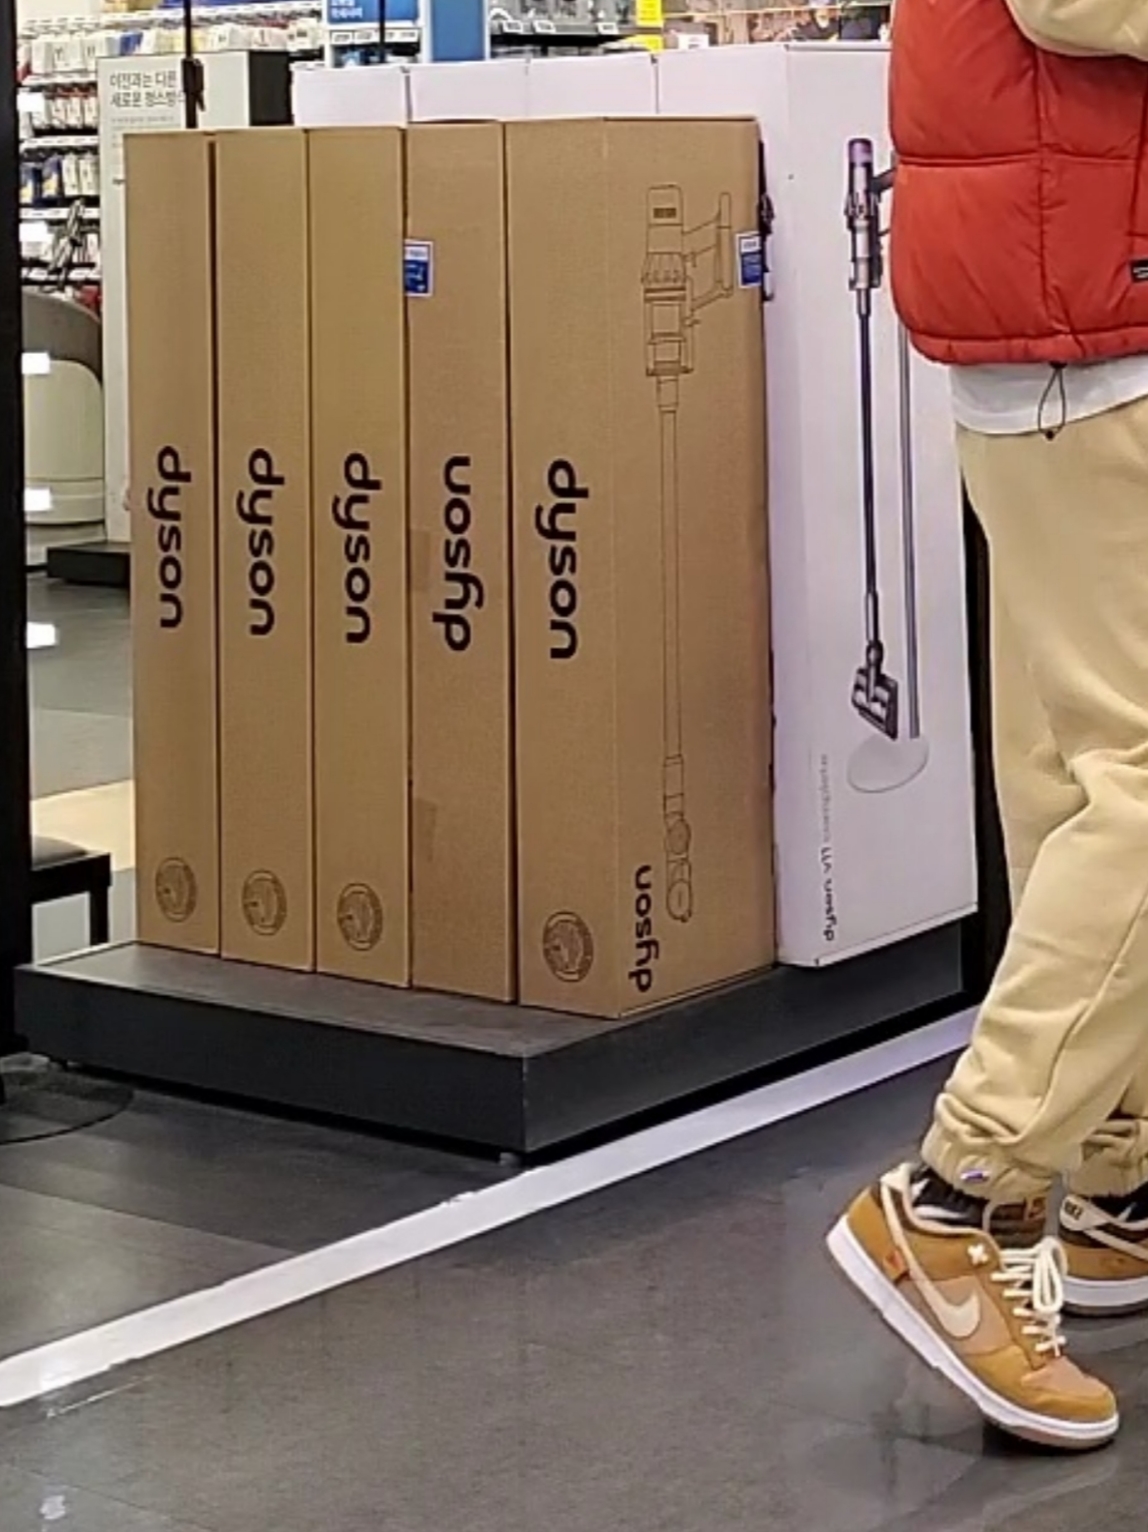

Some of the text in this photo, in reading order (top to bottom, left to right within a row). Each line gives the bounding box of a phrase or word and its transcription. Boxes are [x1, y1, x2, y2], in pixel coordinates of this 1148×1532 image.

[146, 446, 192, 628] dyson
[236, 448, 285, 636] dyson
[331, 452, 382, 644] dyson
[432, 455, 485, 652] dyson
[535, 458, 589, 660] dyson
[628, 864, 660, 993] dyson
[821, 846, 833, 873] v11
[822, 879, 837, 942] dyson
